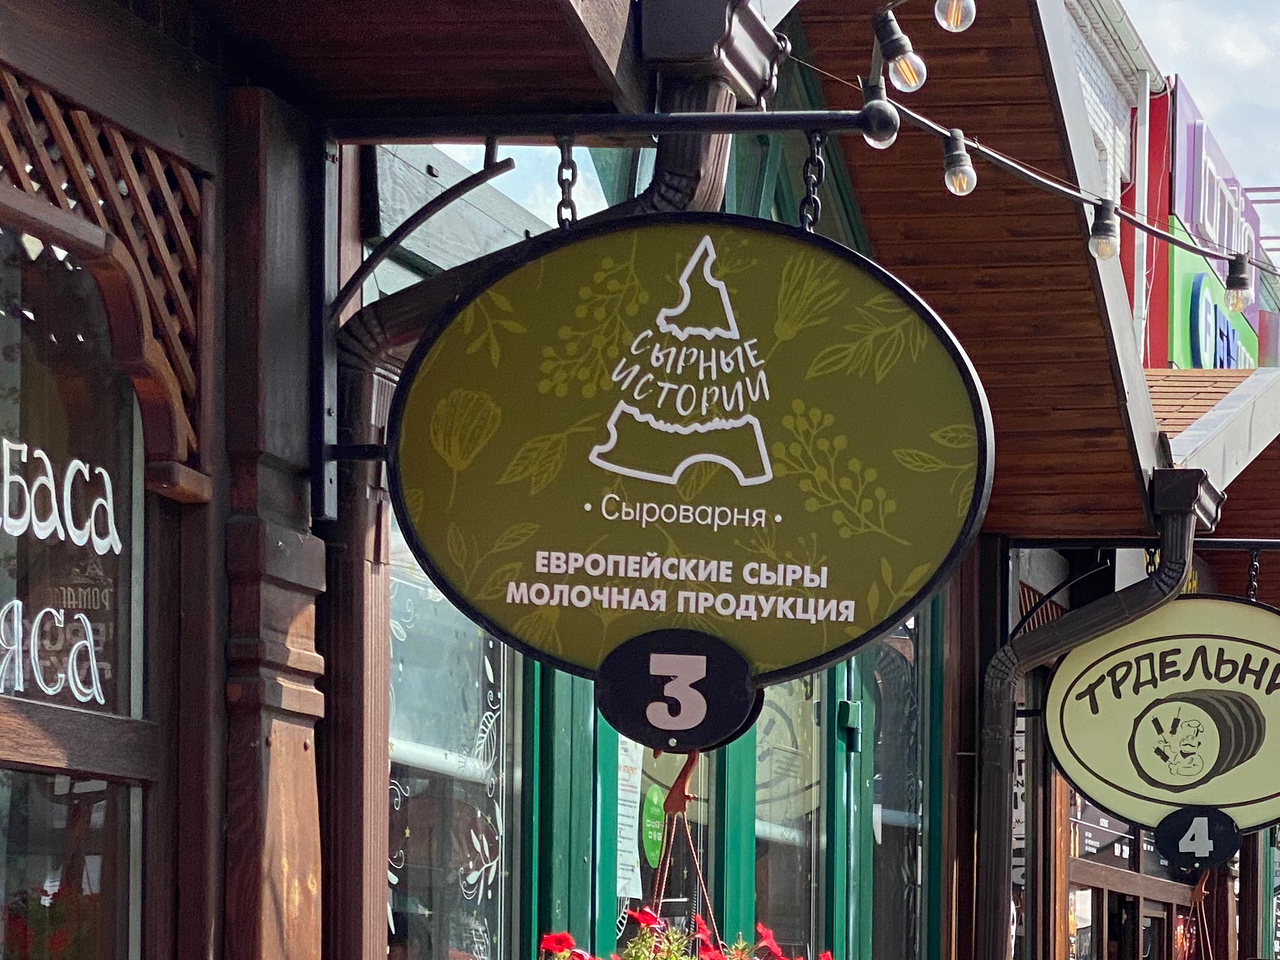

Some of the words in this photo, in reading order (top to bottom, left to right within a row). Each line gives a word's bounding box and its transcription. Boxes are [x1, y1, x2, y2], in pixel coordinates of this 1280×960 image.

[629, 330, 765, 382] СЫРНЫЕ
[611, 359, 769, 416] ИСТОРИИ
[601, 493, 766, 531] Сыроварня
[535, 551, 733, 584] ЕВРОПЕЙСКИЕ
[742, 563, 828, 588] СЫРЫ
[506, 582, 667, 612] МОЛОЧНАЯ
[676, 590, 855, 624] ПРОДУКЦИЯ
[645, 653, 707, 731] 3
[1179, 817, 1214, 857] 4
